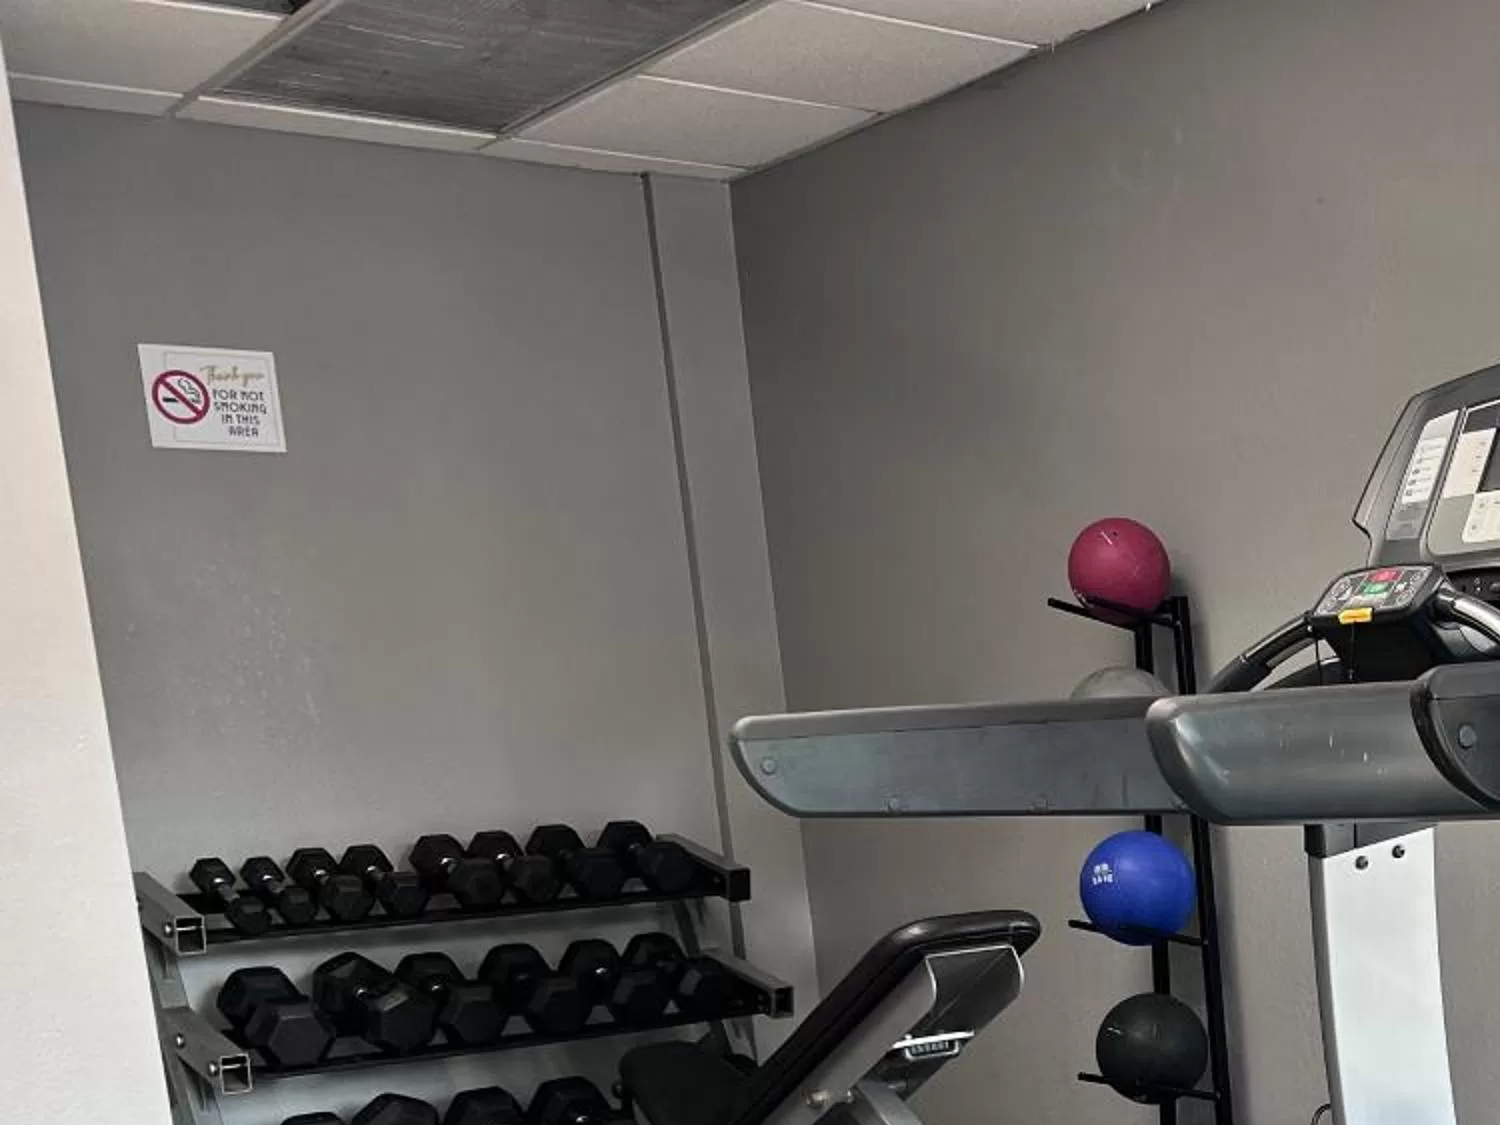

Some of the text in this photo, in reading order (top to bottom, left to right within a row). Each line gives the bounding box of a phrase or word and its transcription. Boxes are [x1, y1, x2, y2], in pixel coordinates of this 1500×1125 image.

[212, 389, 264, 401] FOR NOT
[213, 401, 267, 415] SMOKING
[221, 414, 260, 426] IN THIS
[228, 426, 259, 438] AREA
